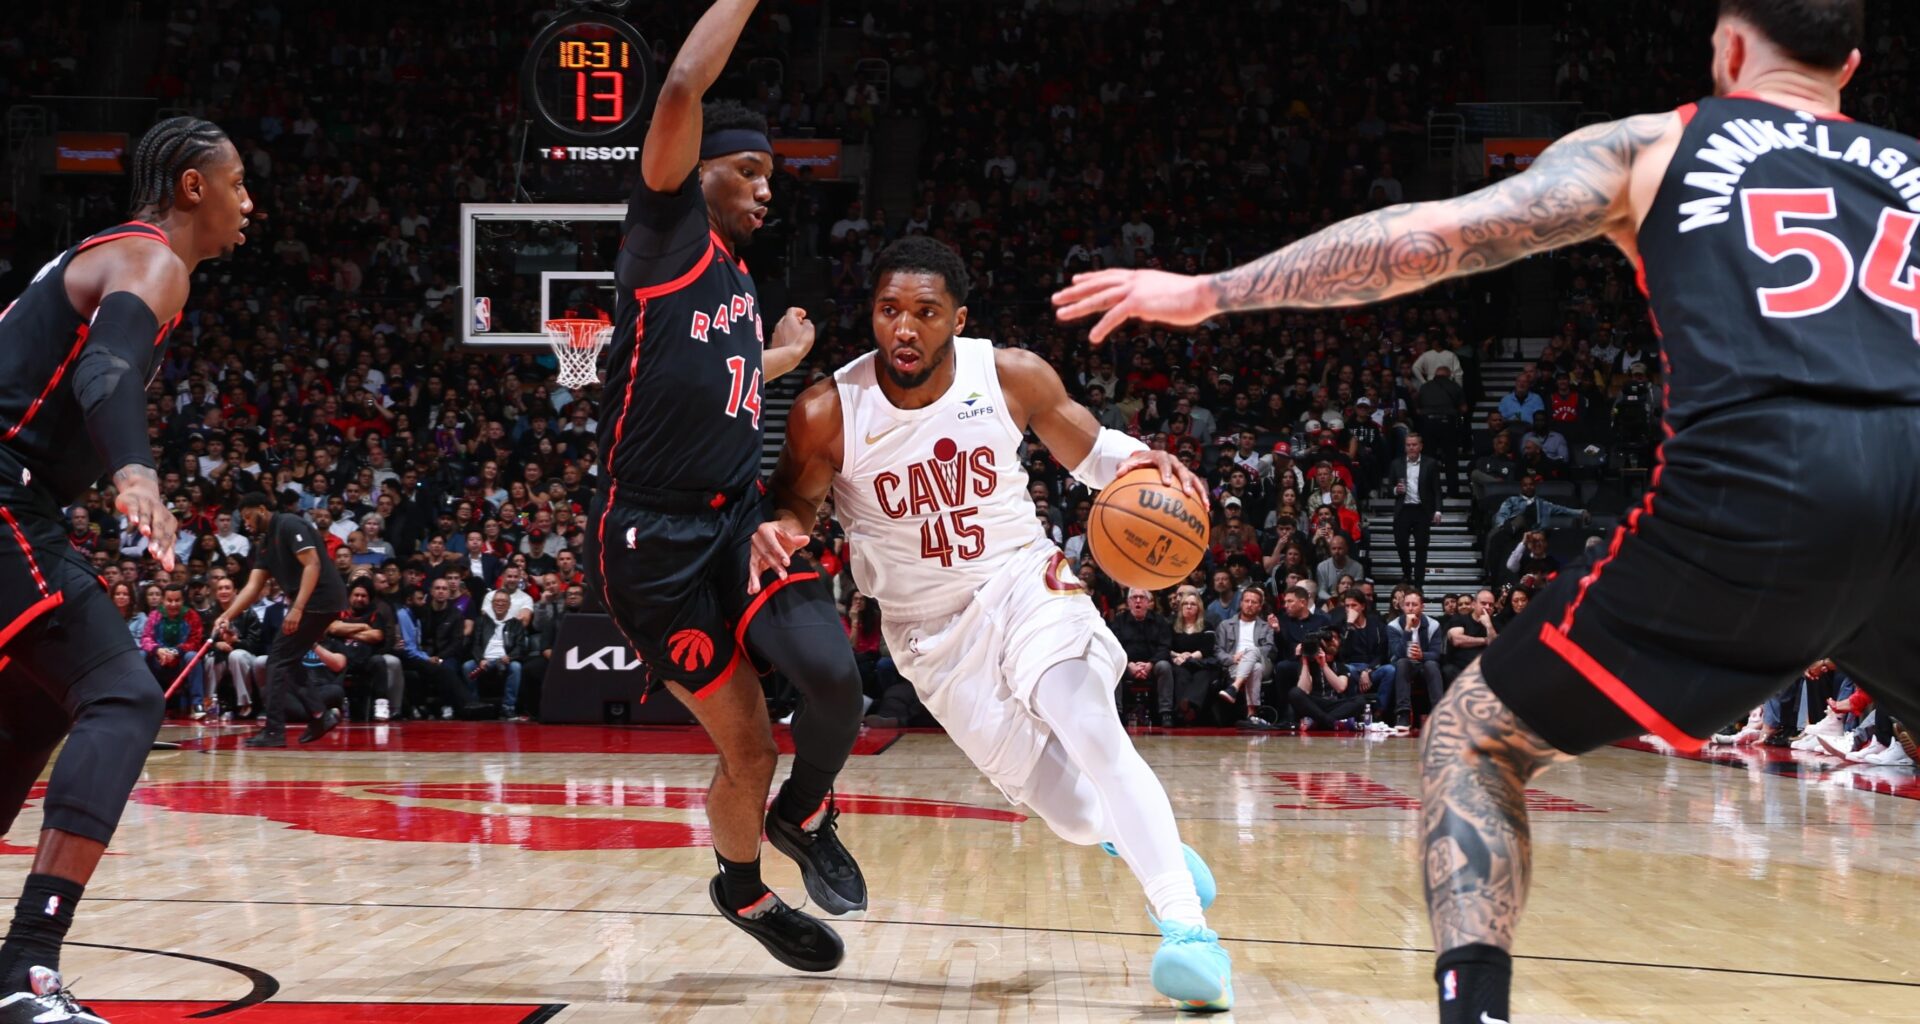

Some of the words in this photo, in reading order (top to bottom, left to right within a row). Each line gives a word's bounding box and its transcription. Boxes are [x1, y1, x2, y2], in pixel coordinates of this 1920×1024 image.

[559, 41, 629, 68] 10:31
[575, 71, 625, 122] 13
[566, 146, 640, 160] TISSOT
[1678, 117, 1920, 233] MAMUKELASH
[1739, 187, 1920, 346] 54
[725, 355, 762, 431] 14
[957, 406, 994, 420] CLIFFS
[873, 441, 998, 520] CAVS
[920, 506, 985, 567] 45
[1138, 489, 1206, 539] Wilson
